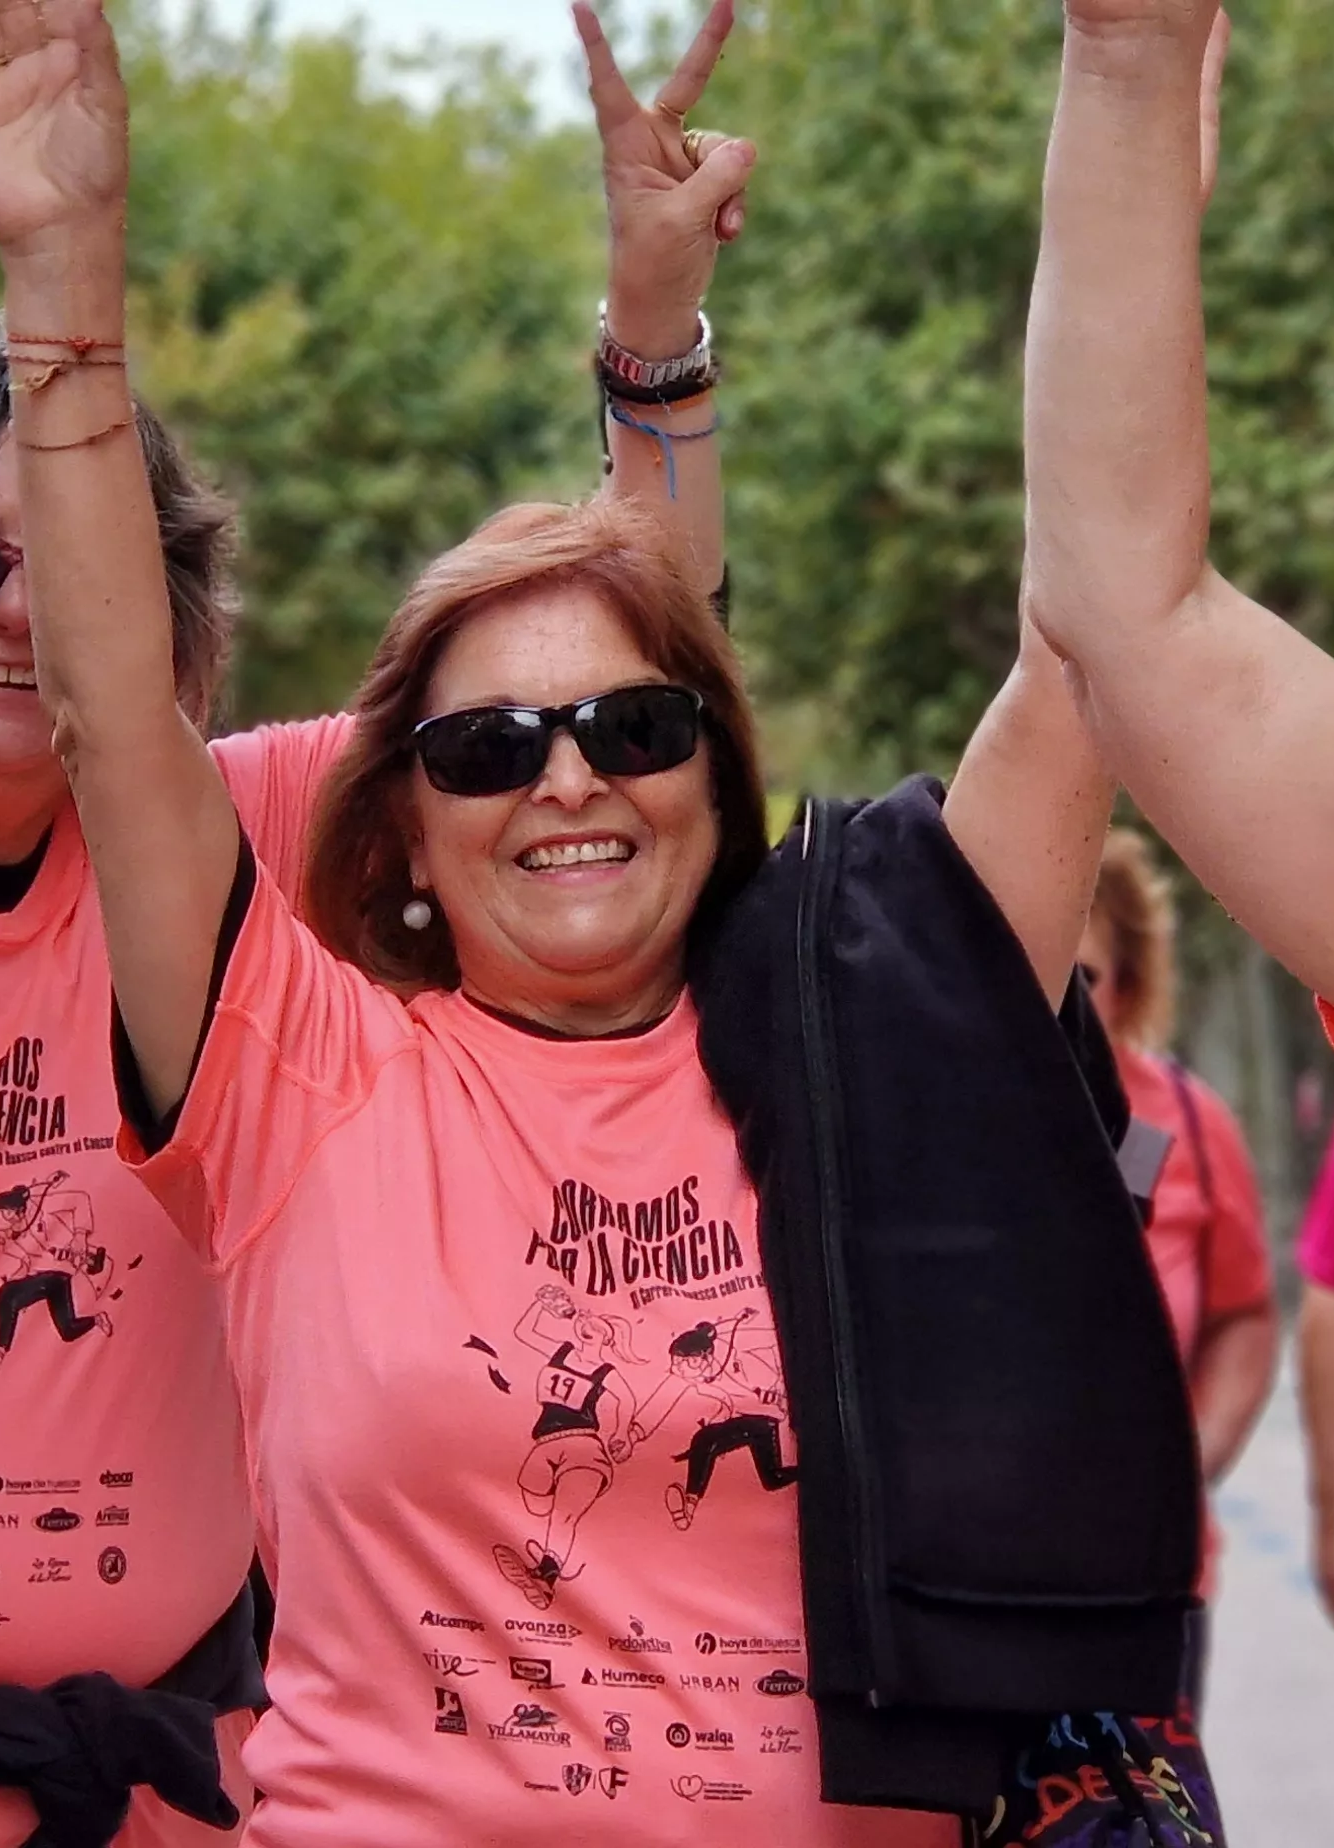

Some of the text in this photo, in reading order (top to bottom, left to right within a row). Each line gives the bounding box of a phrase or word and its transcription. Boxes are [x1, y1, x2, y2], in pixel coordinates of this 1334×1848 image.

[550, 1174, 700, 1245] CORRAMOS
[586, 1232, 617, 1297] LA
[621, 1219, 744, 1286] CIENCIA
[549, 1373, 576, 1401] 19
[505, 1618, 568, 1635] avanza
[602, 1668, 666, 1685] Humeco
[679, 1674, 740, 1691] URBAN
[762, 1679, 801, 1692] Ferrer
[487, 1723, 572, 1747] VILLAMAYOR
[695, 1728, 734, 1747] walqa
